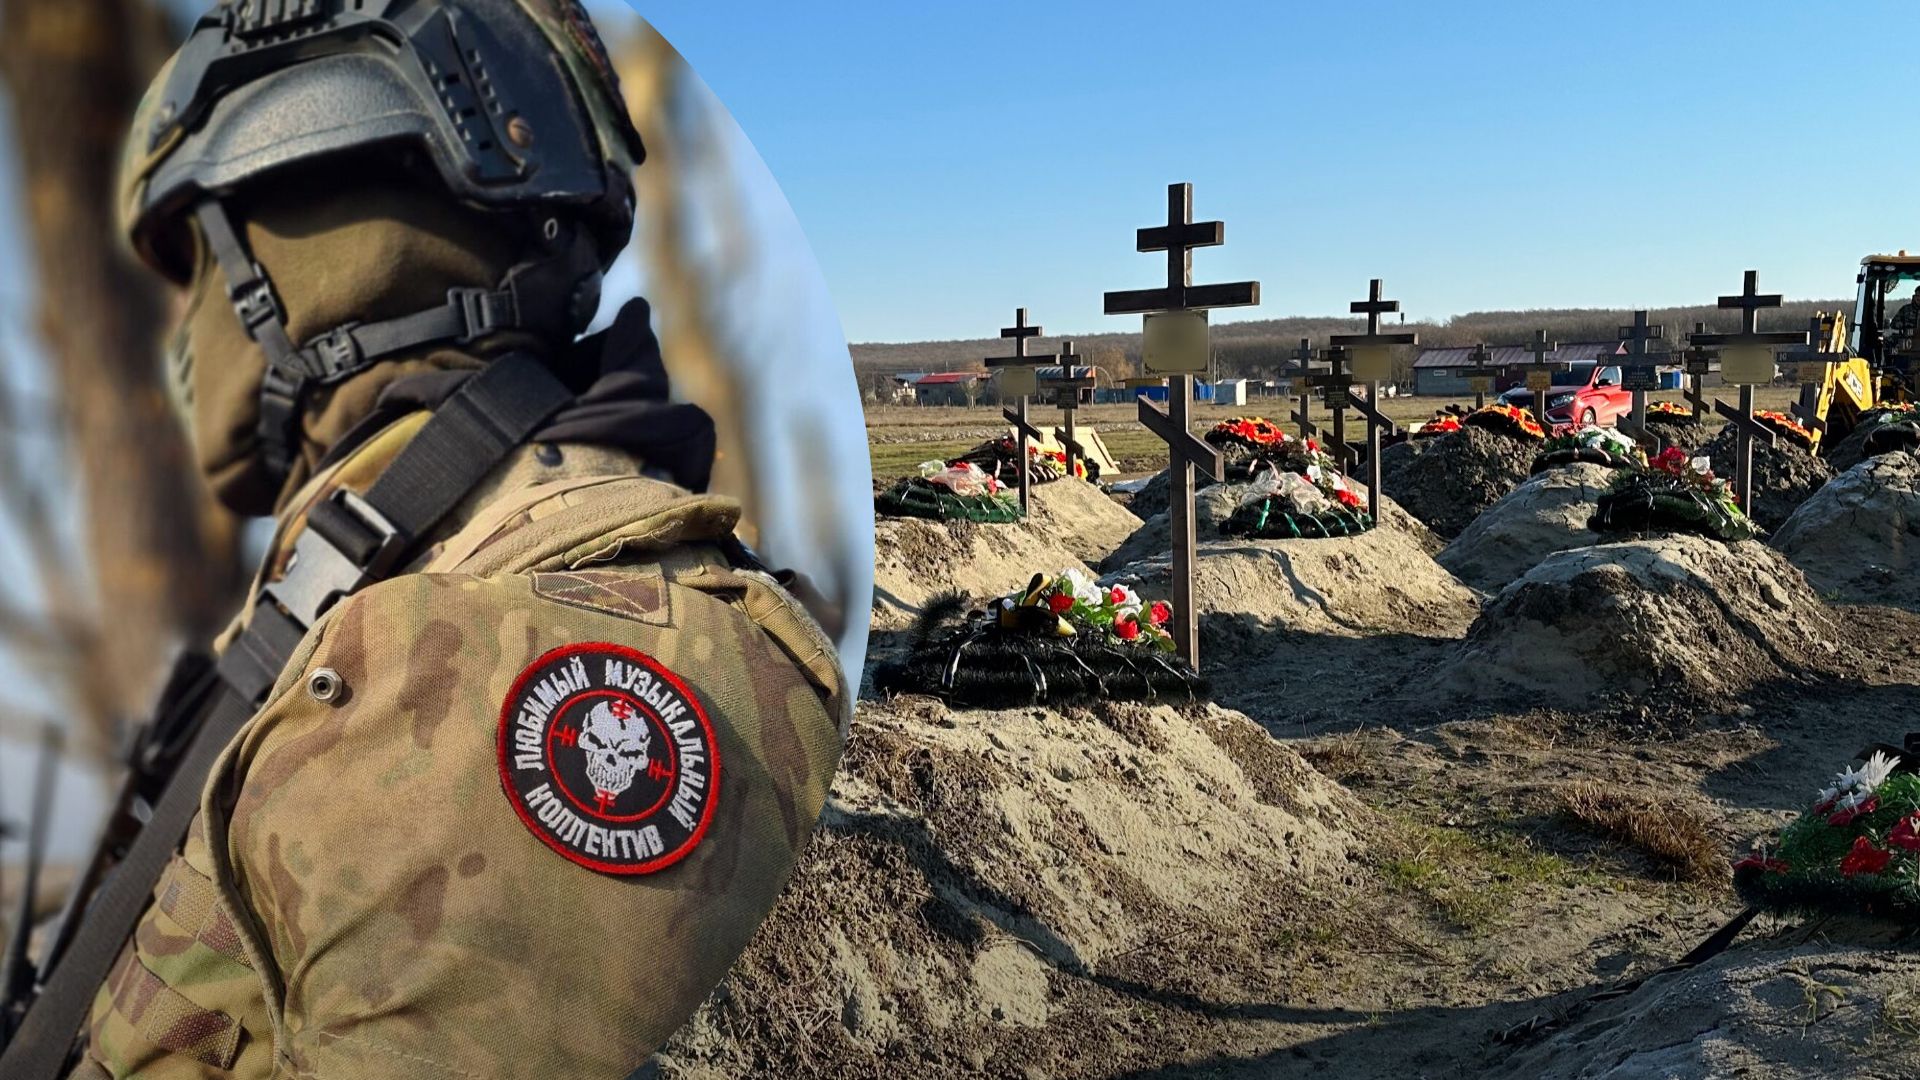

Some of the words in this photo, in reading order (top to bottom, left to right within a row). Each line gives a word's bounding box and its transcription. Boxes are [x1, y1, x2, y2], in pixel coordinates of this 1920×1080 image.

[514, 656, 591, 771] ЛЮБИМЫЙ
[605, 658, 706, 832] МУЗЫКАЛЬНЫЙ
[525, 782, 664, 860] КОЛЛЕКТИВ
